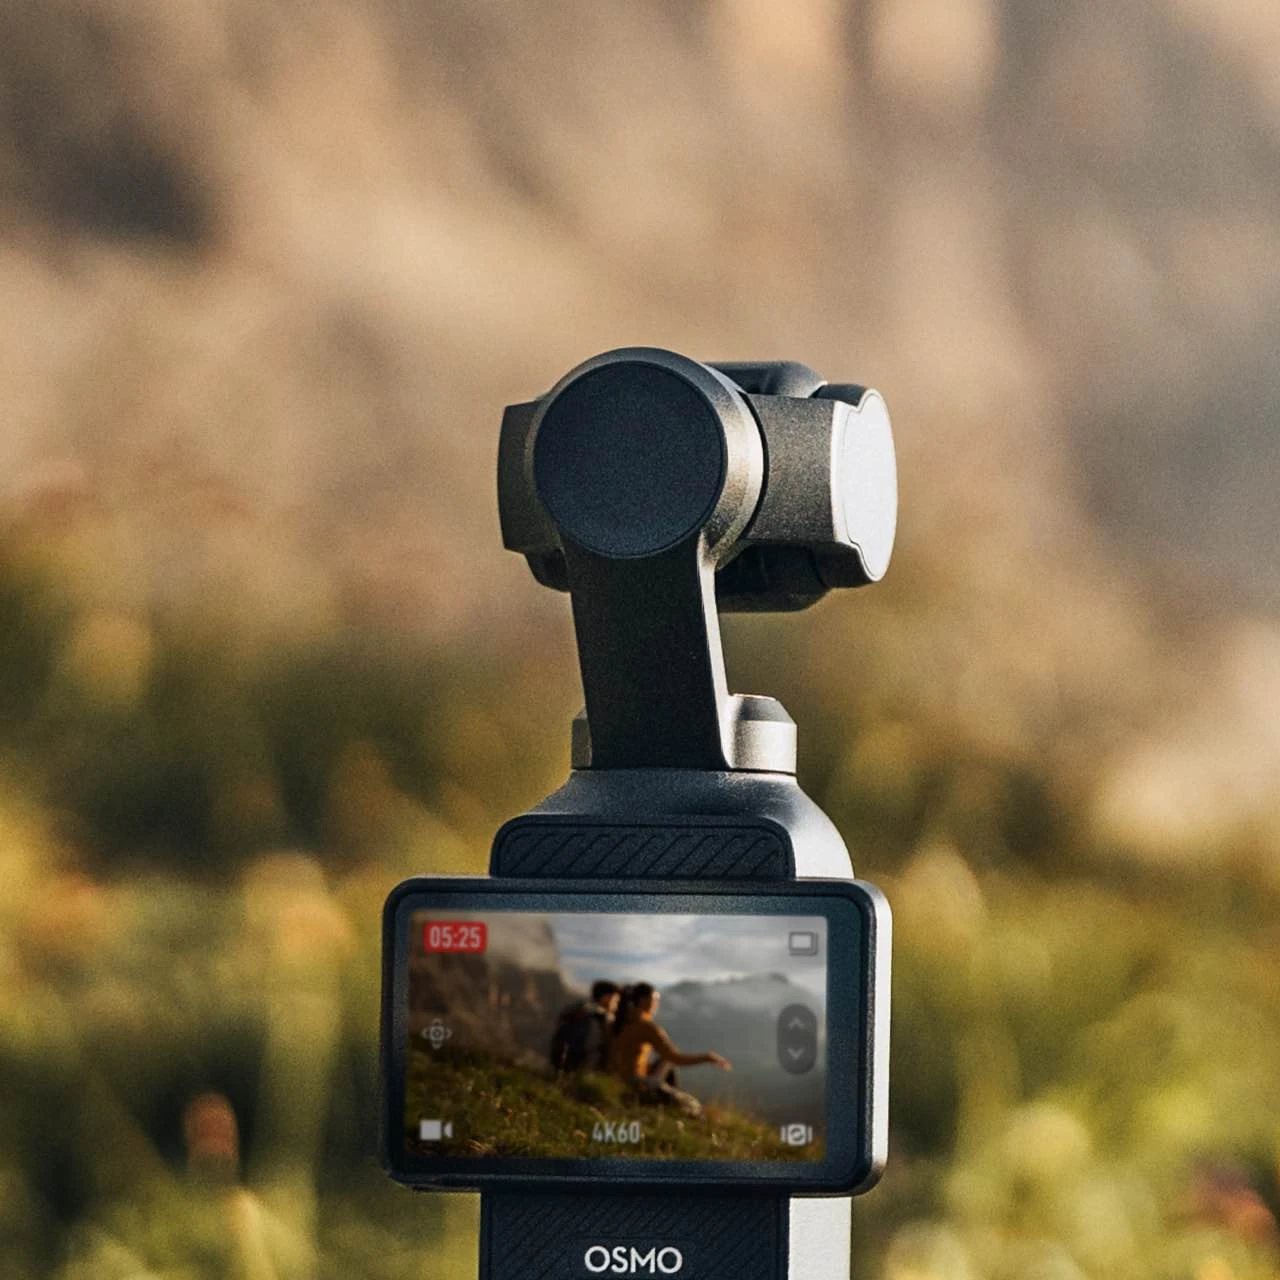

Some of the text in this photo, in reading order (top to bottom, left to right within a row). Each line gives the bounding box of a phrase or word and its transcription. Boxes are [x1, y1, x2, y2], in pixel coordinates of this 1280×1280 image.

[429, 925, 481, 949] 05:25
[592, 1121, 640, 1144] 4K60
[584, 1245, 683, 1274] OSMO
